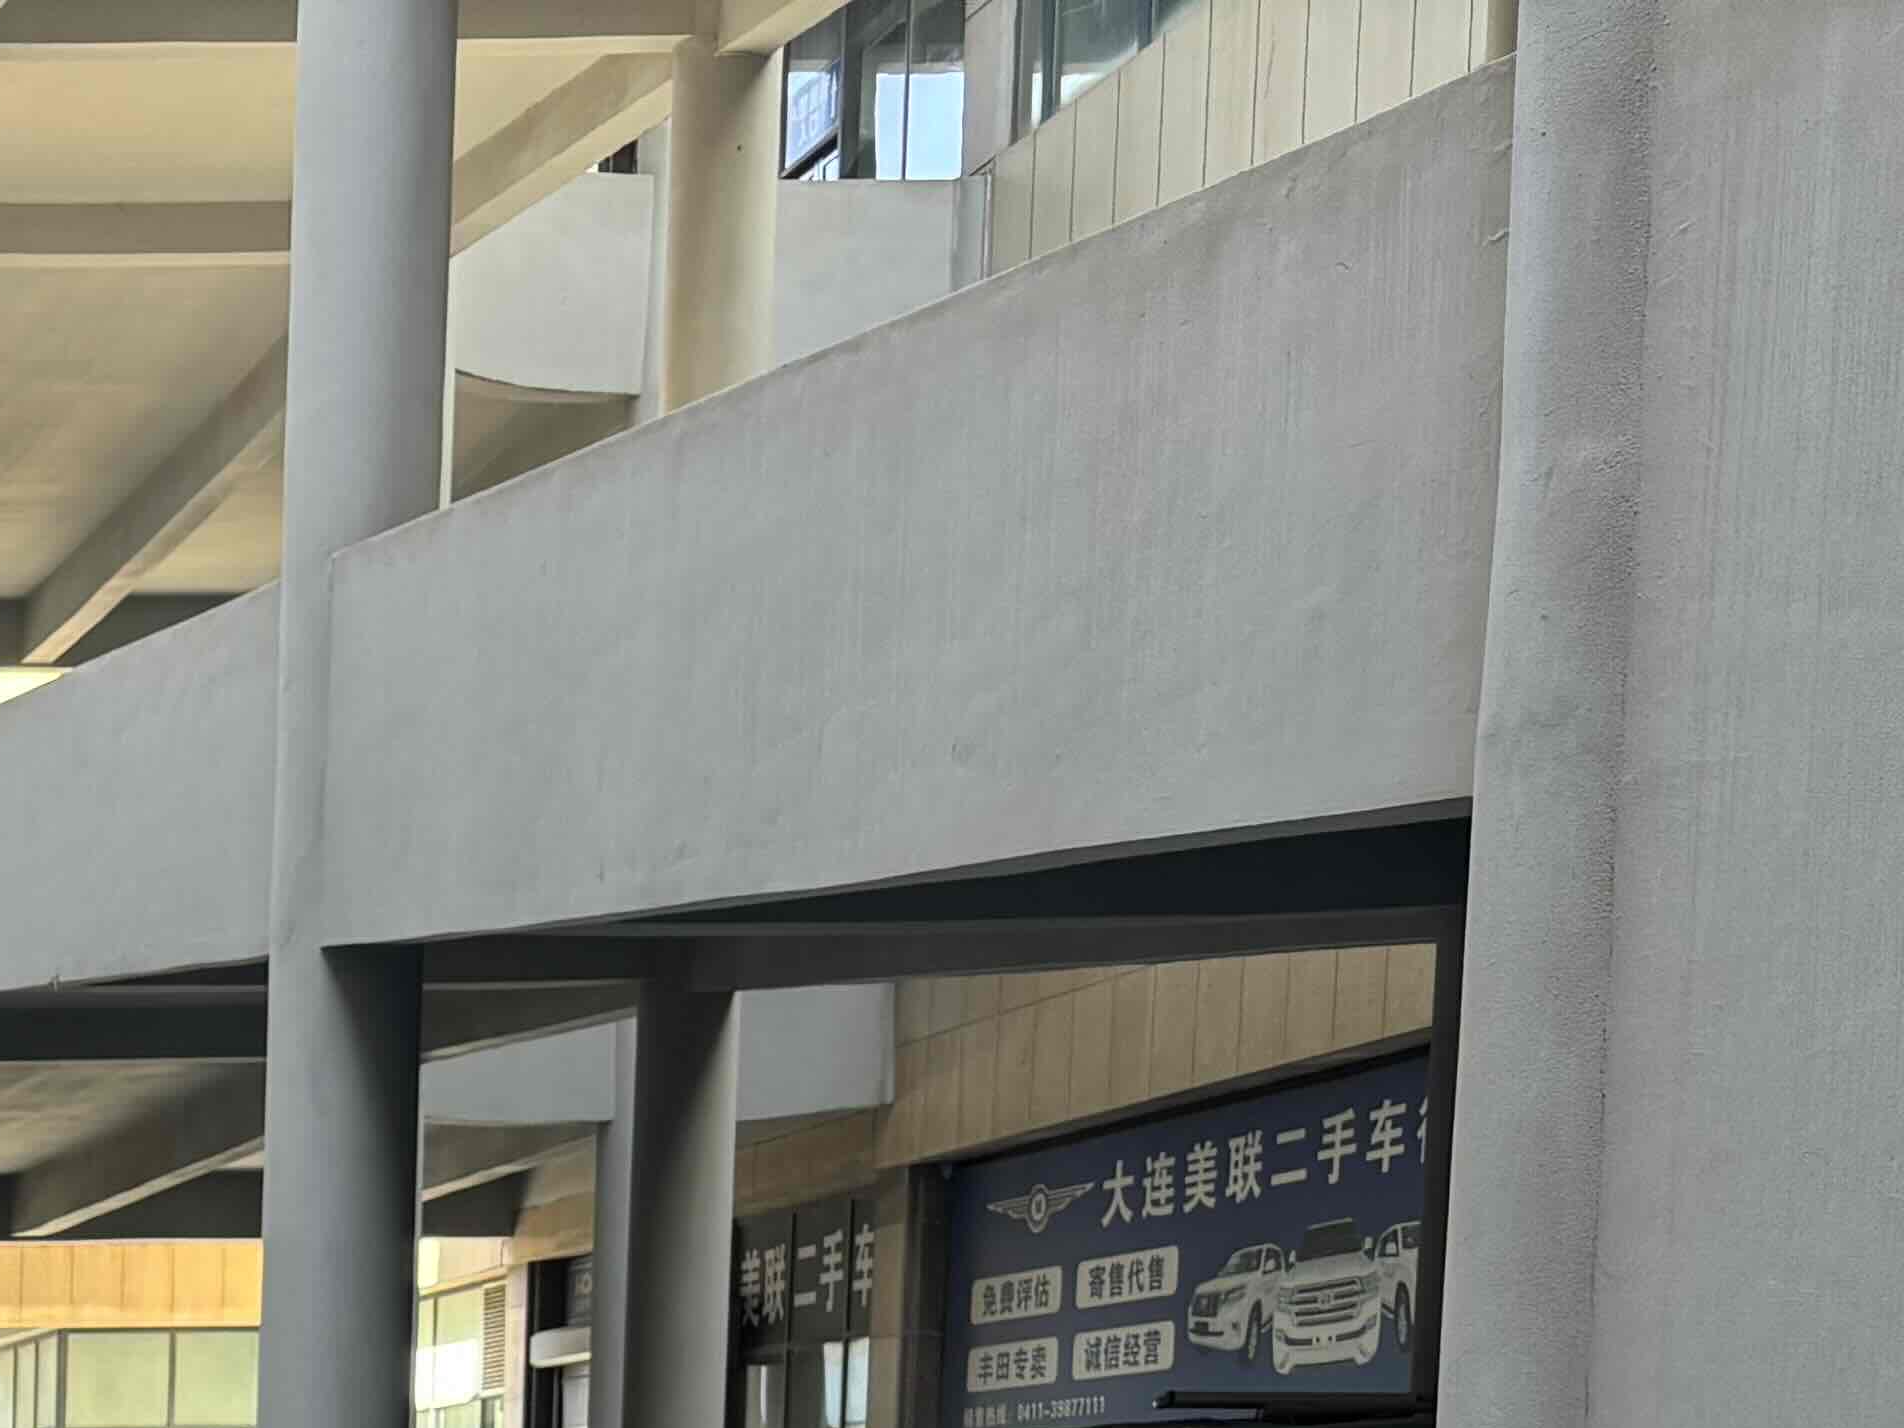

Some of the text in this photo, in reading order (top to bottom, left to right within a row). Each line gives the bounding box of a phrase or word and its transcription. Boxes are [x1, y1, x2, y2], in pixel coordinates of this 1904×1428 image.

[1101, 1096, 1428, 1228] 大连美联二手车
[982, 1274, 1050, 1317] 免费评估
[1088, 1255, 1165, 1300] 寄售代售
[977, 1344, 1047, 1385] 丰田专卖
[1084, 1330, 1161, 1373] 诚信经营
